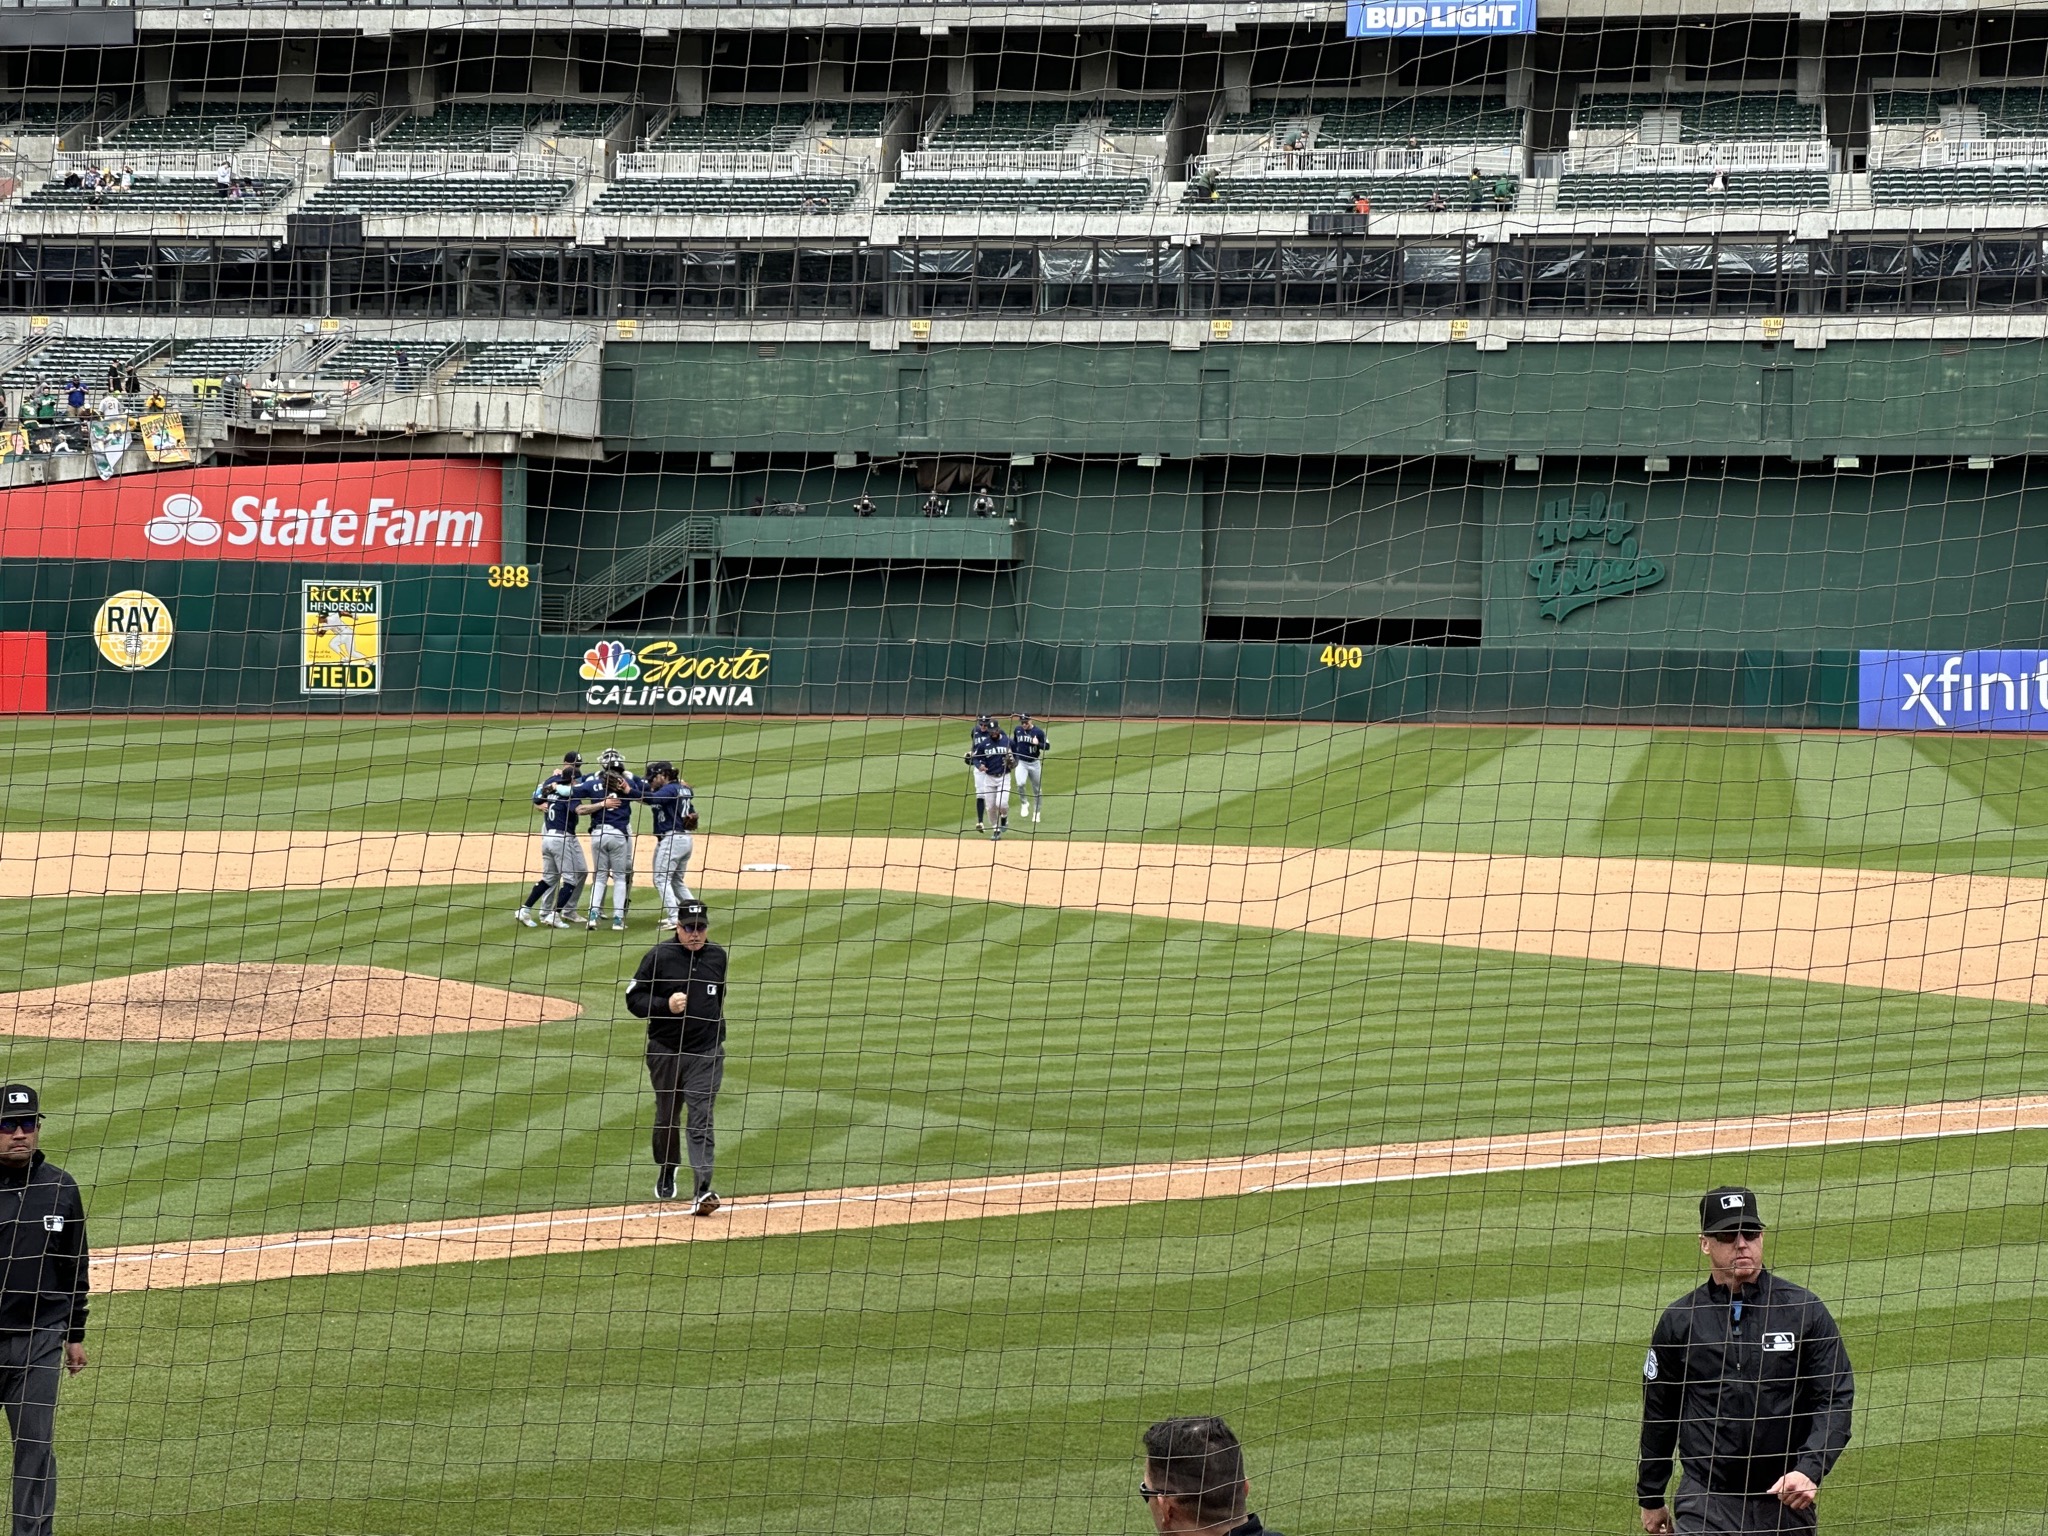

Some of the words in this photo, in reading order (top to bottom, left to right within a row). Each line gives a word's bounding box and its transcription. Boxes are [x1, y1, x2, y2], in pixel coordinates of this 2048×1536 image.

[1366, 6, 1427, 29] BUD
[108, 402, 116, 410] 21
[227, 495, 358, 546] State
[362, 498, 483, 548] Farm
[1538, 491, 1634, 548] Holy
[488, 565, 529, 588] 388
[1528, 537, 1664, 606] Toledo
[310, 586, 373, 602] RICKEY
[310, 602, 373, 612] HENDERSON
[108, 606, 159, 633] RAY
[637, 641, 770, 688] Sports
[1320, 645, 1362, 669] 400
[309, 666, 374, 688] FIELD
[585, 685, 754, 706] CALIFORNIA
